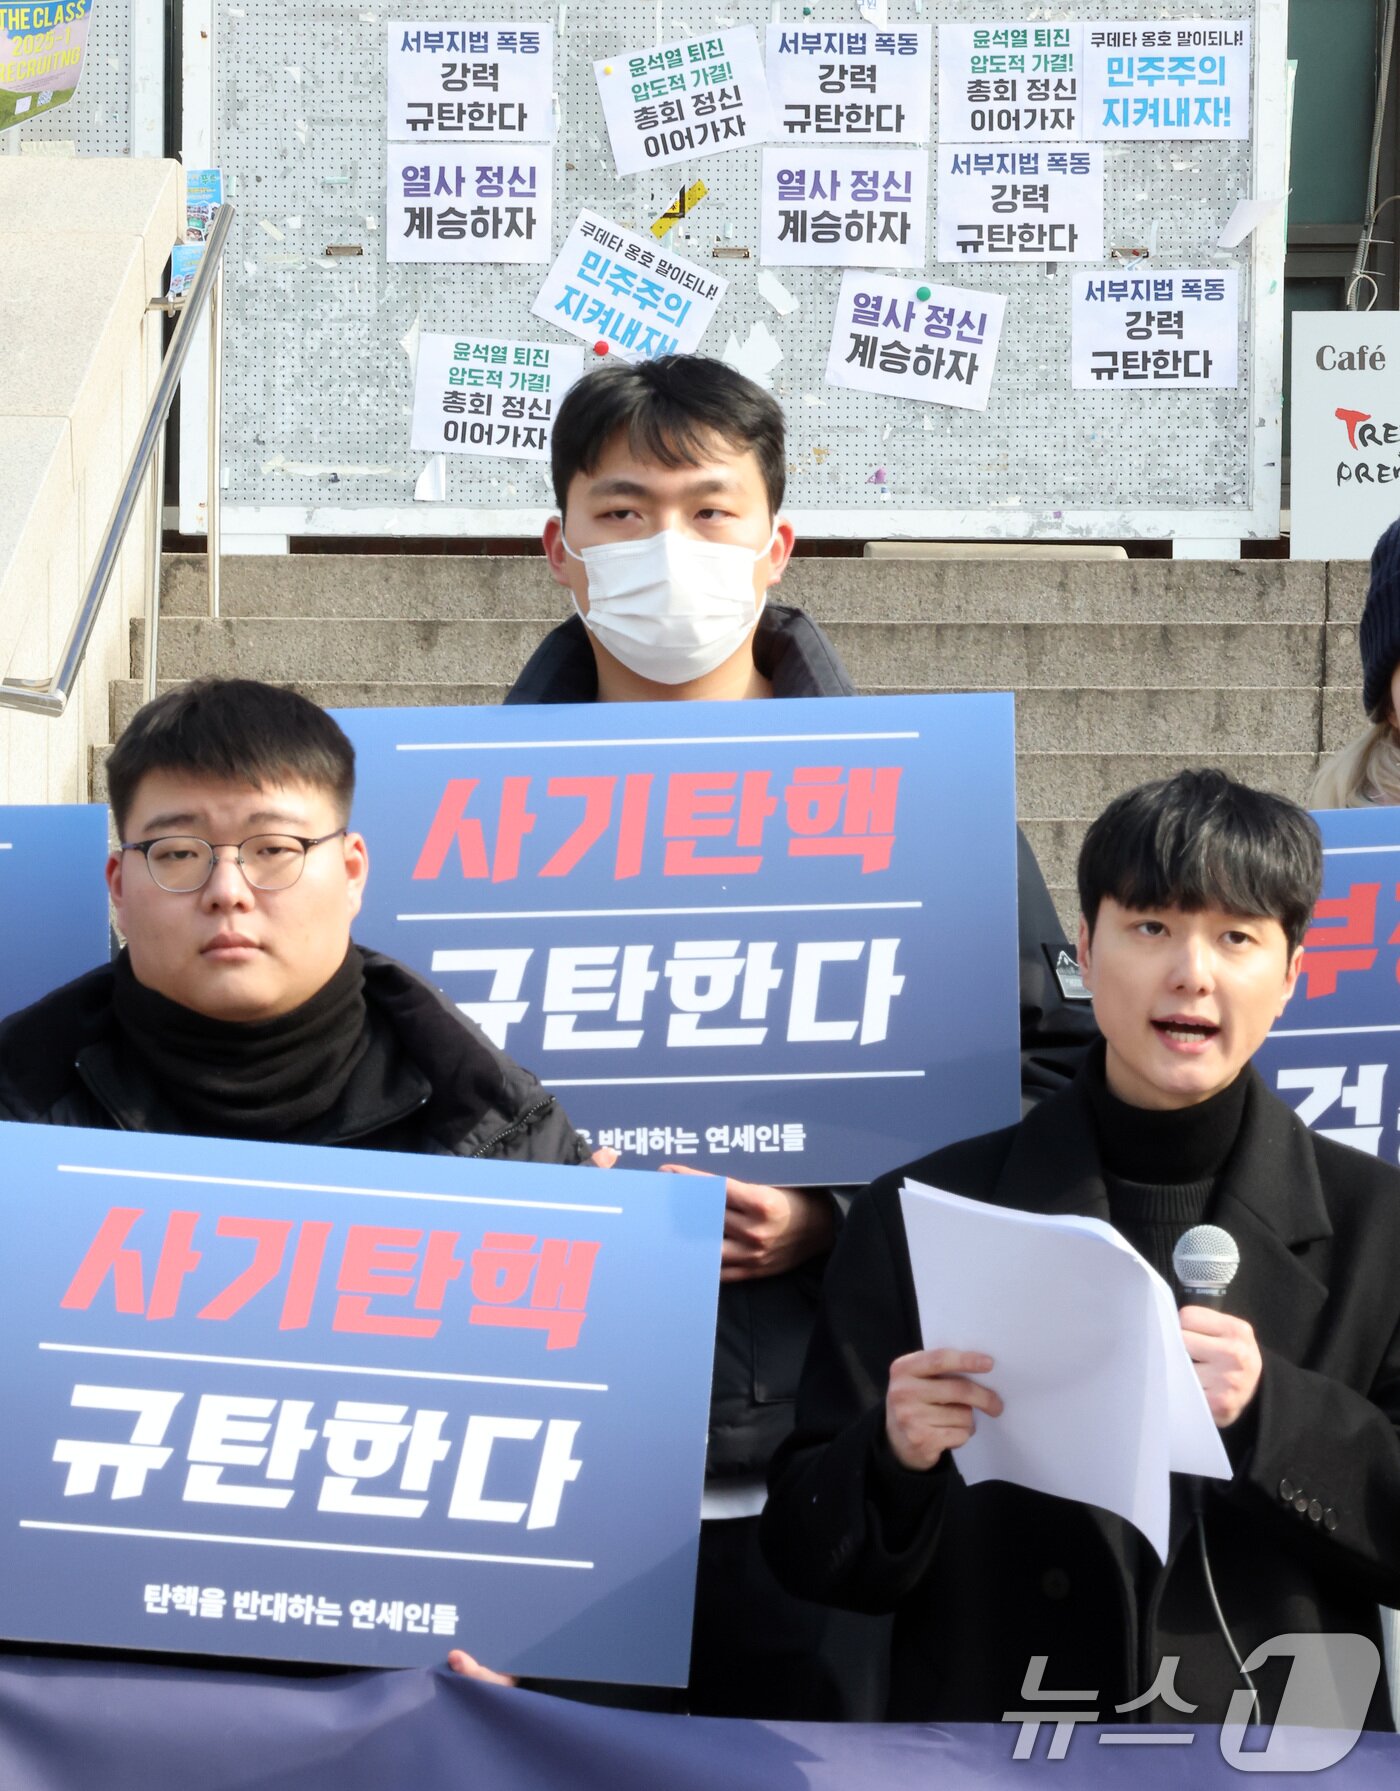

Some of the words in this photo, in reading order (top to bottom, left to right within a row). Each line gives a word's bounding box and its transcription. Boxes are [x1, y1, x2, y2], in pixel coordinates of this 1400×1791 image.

[0, 8, 30, 30] THE
[33, 0, 86, 28] CLASS
[12, 26, 71, 57] 2025-1
[401, 31, 489, 54] 서부지법
[496, 31, 540, 54] 폭동
[778, 32, 866, 55] 서부지법
[876, 32, 918, 55] 폭동
[973, 30, 1028, 49] 윤석열
[1034, 29, 1071, 48] 퇴진
[1091, 31, 1138, 47] 쿠데타
[1141, 31, 1172, 47] 옹호
[1177, 30, 1244, 47] 말이되냐!
[628, 46, 683, 77] 윤석열
[688, 38, 725, 64] 퇴진
[970, 55, 1026, 74] 압도적
[1032, 54, 1074, 73] 가결!
[1107, 56, 1226, 87] 민주주의
[440, 63, 499, 92] 강력
[631, 76, 687, 103] 압도적
[692, 61, 733, 91] 가결!
[818, 64, 876, 93] 강력
[966, 78, 1017, 102] 총회
[1026, 78, 1077, 102] 정신
[406, 102, 527, 132] 규탄한다
[634, 98, 686, 131] 총회
[691, 85, 743, 115] 정신
[783, 103, 905, 134] 규탄한다
[971, 107, 1075, 132] 이어가자
[1102, 97, 1231, 128] 지켜내자!
[645, 115, 746, 158] 이어가자
[951, 153, 1039, 176] 서부지법
[1047, 153, 1091, 176] 폭동
[402, 166, 464, 198] 열사
[475, 166, 537, 198] 정신
[776, 169, 841, 202] 열사
[850, 169, 912, 202] 정신
[991, 184, 1049, 214] 강력
[403, 206, 537, 240] 계승하자
[778, 209, 911, 245] 계승하자
[956, 223, 1078, 254] 규탄한다
[580, 221, 624, 252] 쿠데타
[625, 243, 655, 268] 옹호
[655, 258, 719, 301] 말이되냐!
[577, 249, 692, 328] 민주주의
[1085, 279, 1173, 302] 서부지법
[1181, 279, 1225, 302] 폭동
[555, 284, 679, 358] 지켜내자!
[851, 291, 915, 333] 열사
[924, 302, 988, 344] 정신
[1125, 309, 1184, 340] 강력
[453, 342, 507, 365] 윤석열
[513, 347, 549, 368] 퇴진
[845, 332, 979, 385] 계승하자
[1091, 349, 1212, 380] 규탄한다
[1316, 345, 1386, 370] Café
[449, 367, 502, 389] 압도적
[509, 371, 550, 392] 가결!
[442, 390, 492, 416] 총회
[501, 393, 551, 421] 정신
[443, 420, 547, 449] 이어가자
[412, 766, 902, 883] 사기탄핵
[1300, 882, 1400, 1000] 부
[431, 939, 906, 1050] 규탄한다
[1276, 1063, 1400, 1164] 검
[598, 1126, 699, 1155] 반대하는
[705, 1123, 806, 1153] 연세인들
[59, 1206, 601, 1351] 사기탄핵
[52, 1384, 584, 1531] 규탄한다
[143, 1583, 227, 1618] 탄핵을
[233, 1591, 343, 1626] 반대하는
[349, 1598, 459, 1635] 연세인들
